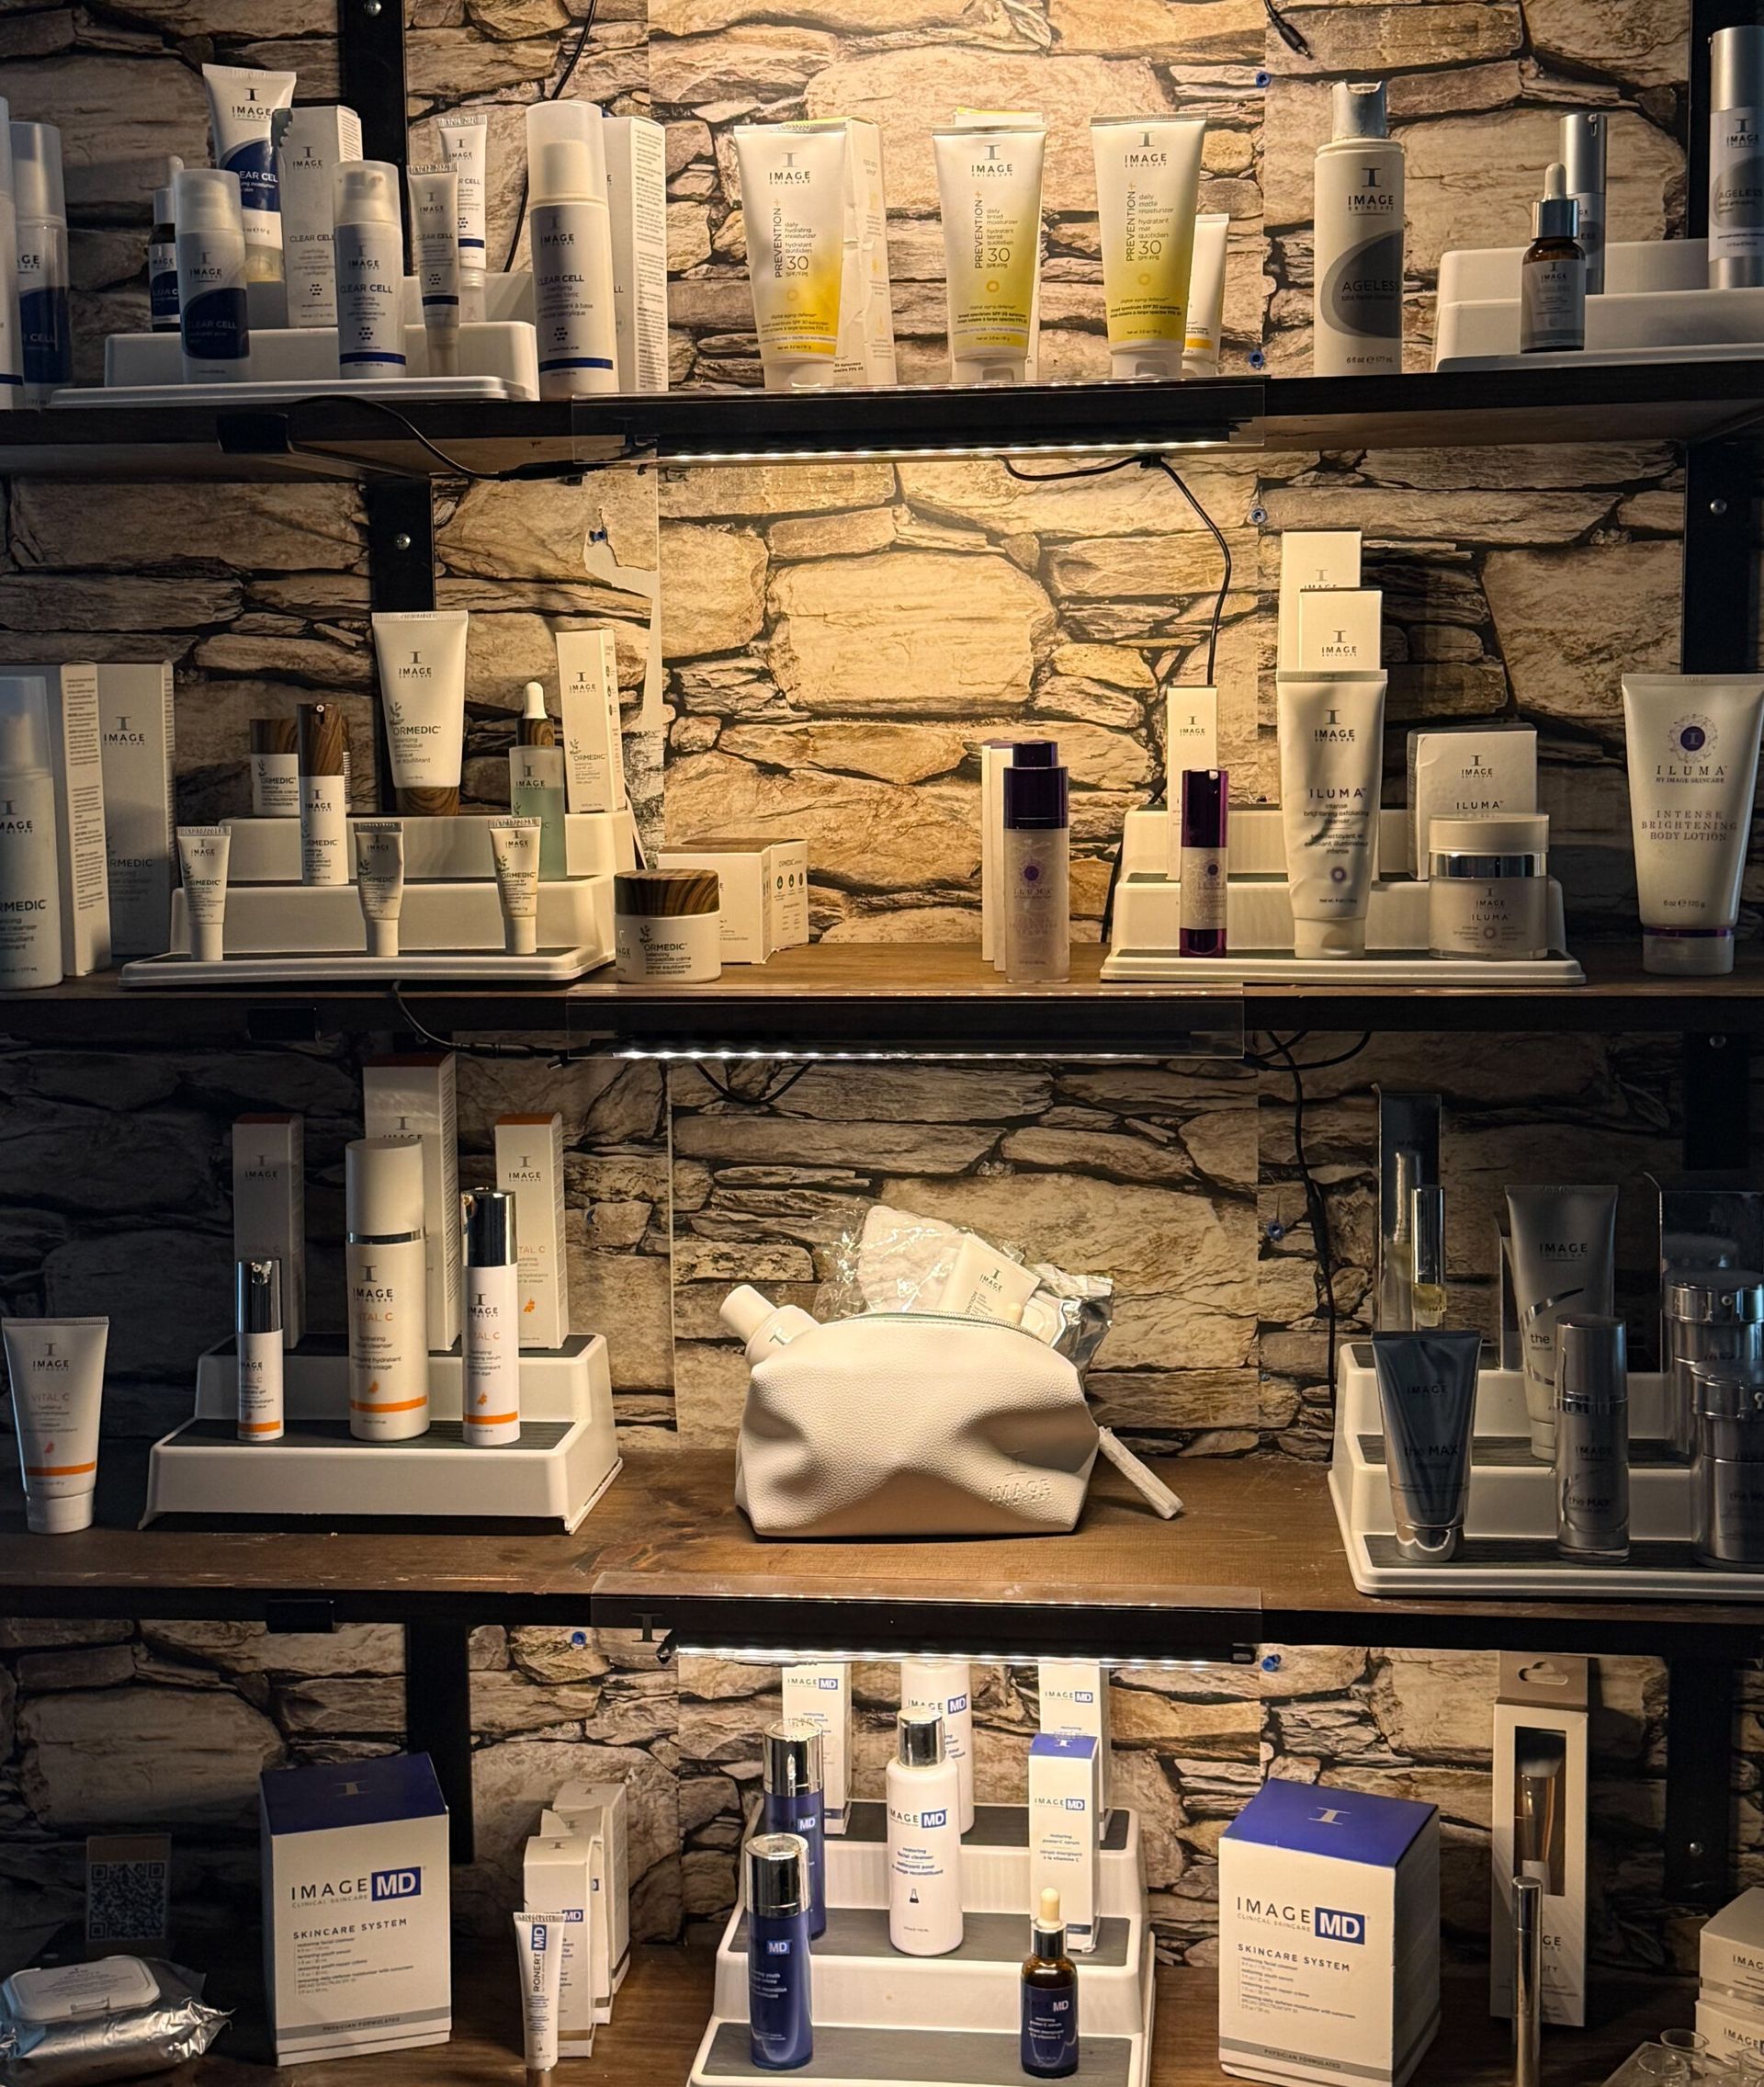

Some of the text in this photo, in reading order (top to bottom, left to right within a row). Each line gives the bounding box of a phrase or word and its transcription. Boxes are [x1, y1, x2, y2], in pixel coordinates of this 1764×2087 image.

[232, 106, 272, 116] IMAGE
[293, 159, 322, 167] IMAGE
[1125, 153, 1167, 164] IMAGE
[971, 164, 1013, 173] IMAGE
[769, 171, 811, 181] IMAGE
[1348, 195, 1395, 205] IMAGE
[420, 205, 444, 213] IMAGE
[540, 234, 574, 244] IMAGE
[1138, 240, 1162, 255] 30
[988, 247, 1011, 263] 30
[786, 255, 809, 271] 30
[562, 275, 585, 283] CELL
[369, 284, 393, 294] CELL
[1321, 646, 1357, 654] IMAGE
[104, 733, 145, 742] IMAGE
[1315, 730, 1355, 738] IMAGE
[1657, 766, 1724, 776] ILUMA
[1657, 811, 1723, 819] INTENSE
[1642, 822, 1737, 830] BRIGHTENING
[1650, 832, 1727, 841] BODY LOTION
[109, 858, 153, 868] RMEDIC
[245, 1171, 278, 1179] IMAGE
[1539, 1243, 1588, 1253] IMAGE
[353, 1288, 393, 1298] IMAGE
[1531, 1333, 1550, 1344] the
[820, 1680, 837, 1688] MD
[1045, 1691, 1092, 1702] IMAGE MD
[949, 1697, 966, 1711] MD
[1035, 1798, 1084, 1809] IMAGE MD
[889, 1809, 945, 1827] MAGE MD
[800, 1818, 816, 1830] MD
[291, 1872, 416, 1900] IMAGE MD
[565, 1911, 582, 1921] MD
[1237, 1896, 1360, 1939] IMAGE MD
[293, 1919, 407, 1940] SKINCARE SYSTEM
[534, 1926, 545, 1948] MD
[769, 1942, 787, 1953] MD
[1238, 1944, 1350, 1972] SKINCARE SYSTEM
[1733, 1955, 1764, 1969] IMAG
[533, 1953, 541, 1992] RONERT
[1053, 2000, 1069, 2012] MD
[1724, 2027, 1758, 2047] IMAGE
